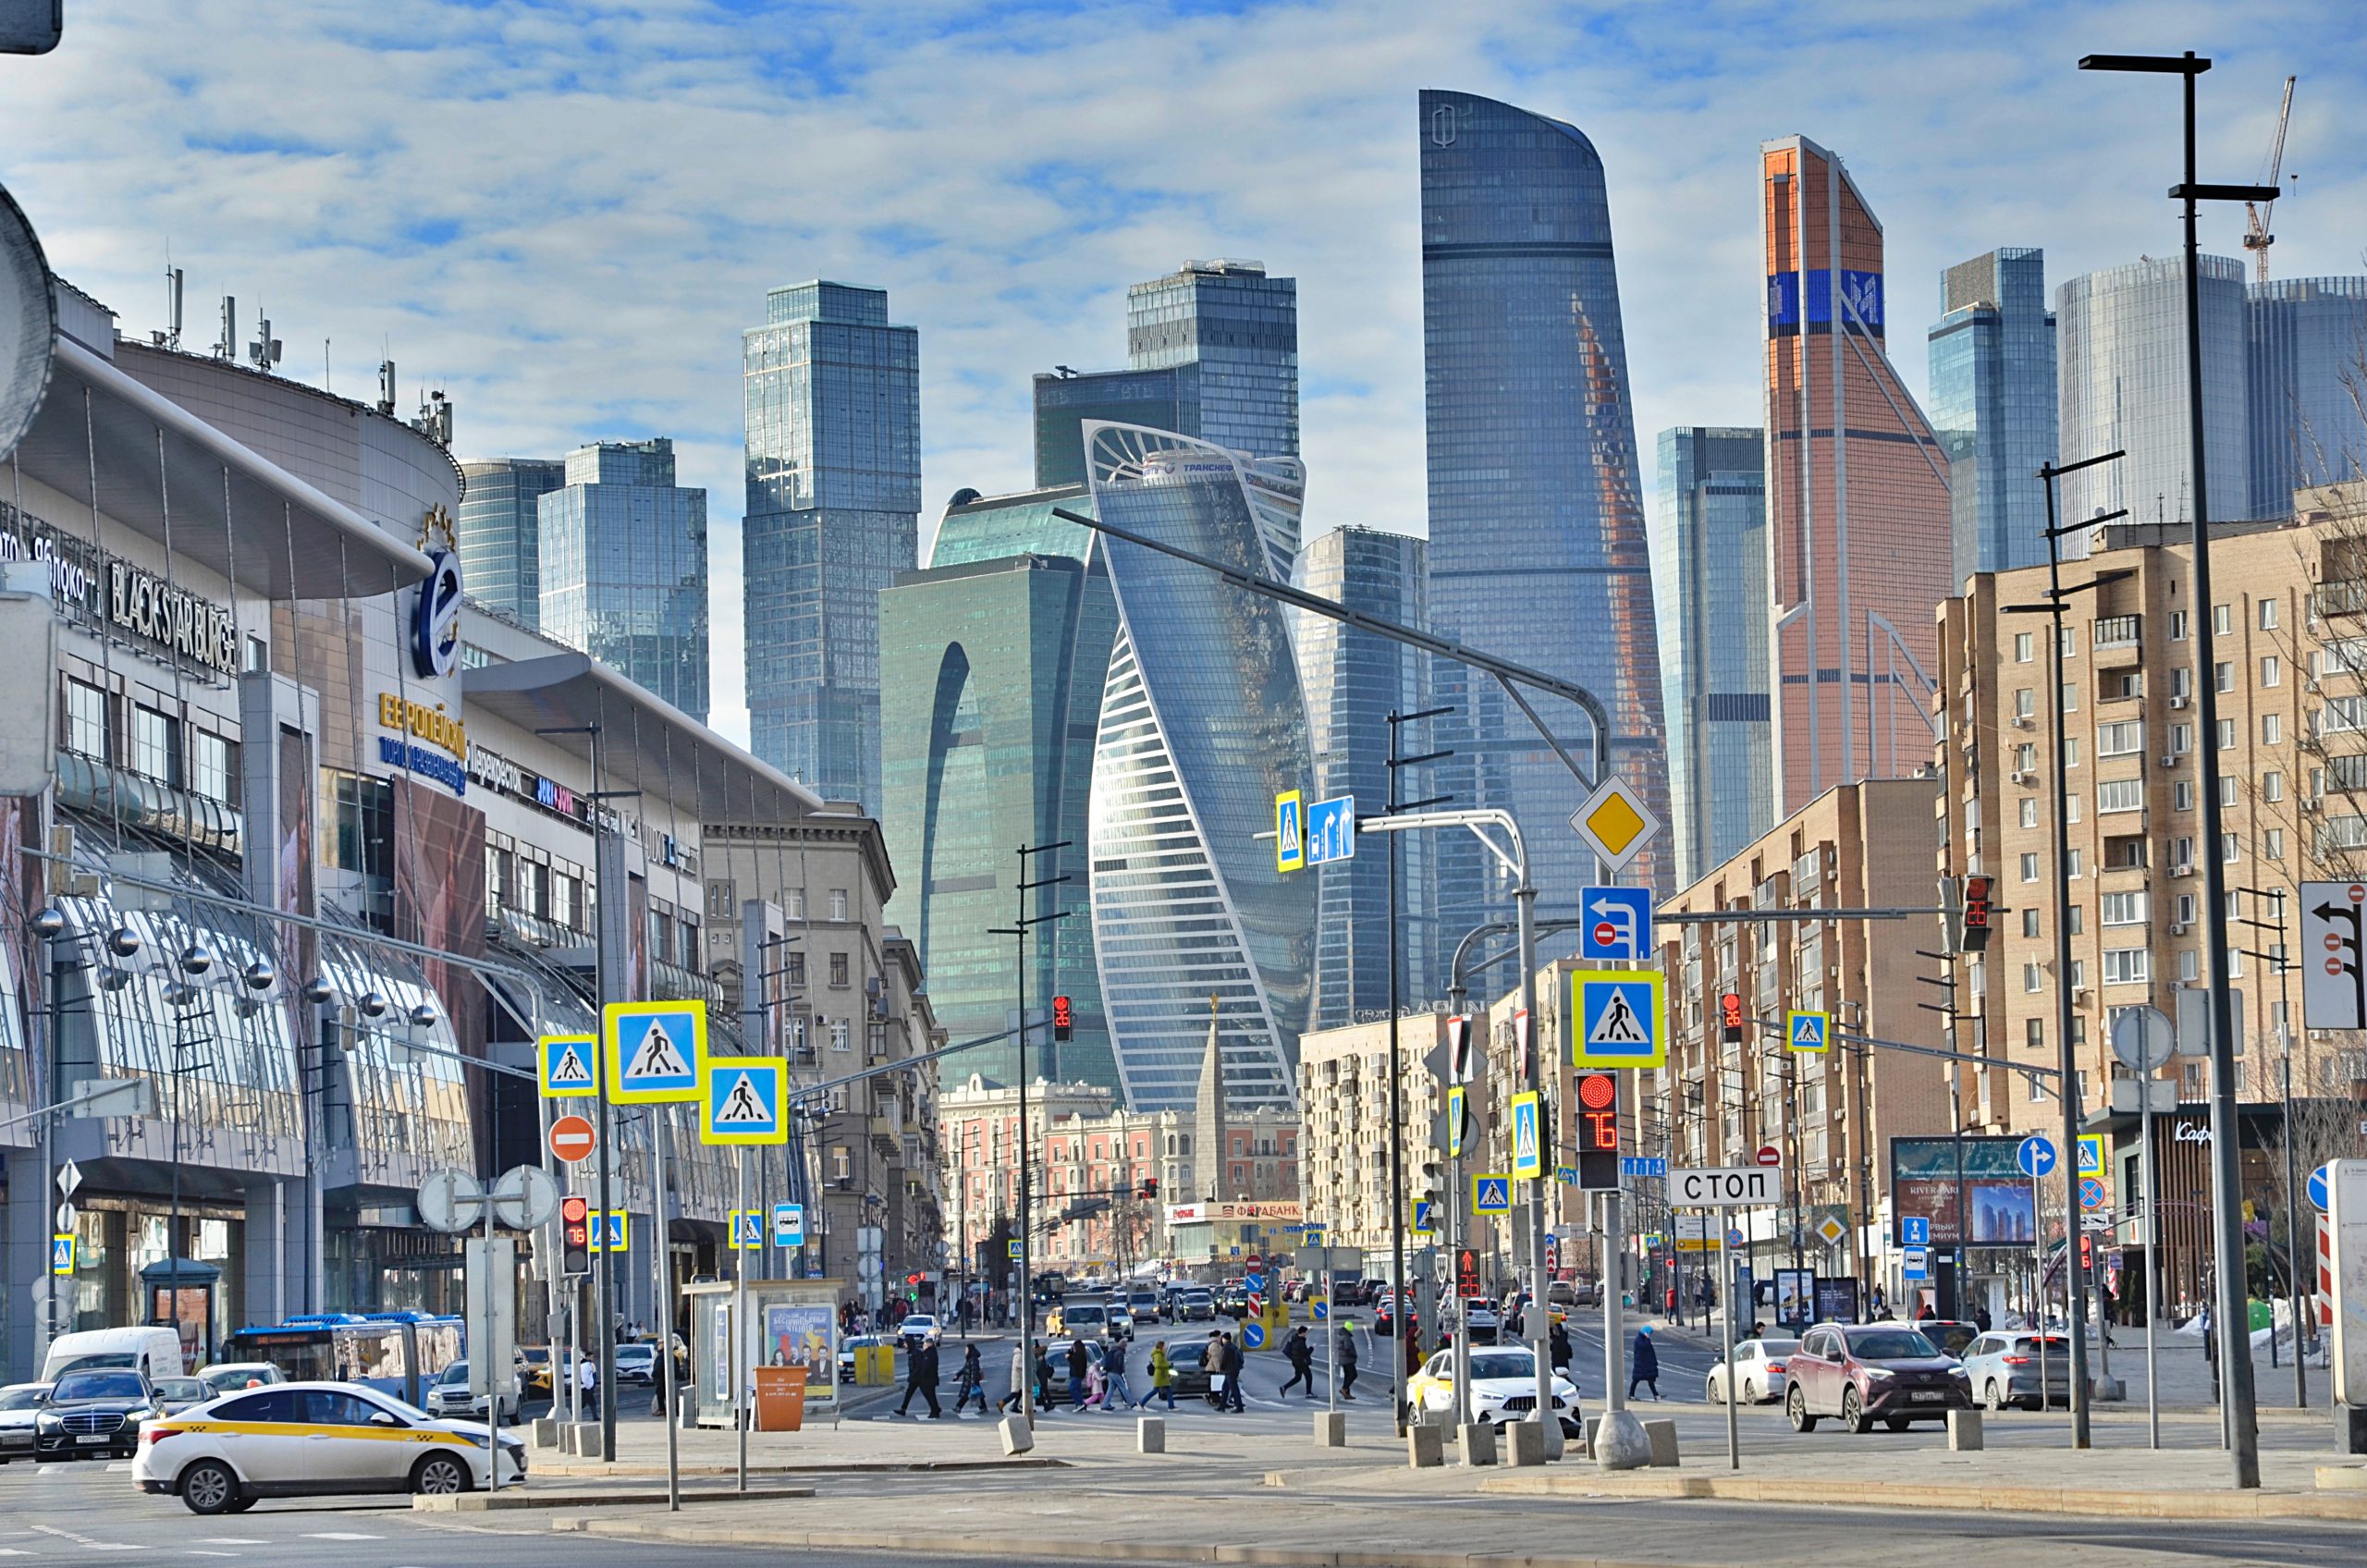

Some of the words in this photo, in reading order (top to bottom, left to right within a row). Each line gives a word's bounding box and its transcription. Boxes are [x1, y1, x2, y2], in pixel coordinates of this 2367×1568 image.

[111, 562, 161, 639] BLACK
[1056, 1011, 1069, 1026] 26
[1726, 1012, 1739, 1025] 26
[1586, 1114, 1616, 1147] 76
[1685, 1174, 1765, 1198] СТОП
[1910, 1186, 1936, 1194] RIVER
[1939, 1186, 1959, 1194] PAR
[1237, 1205, 1299, 1217] ФРАБАНК
[568, 1228, 583, 1243] 76
[1460, 1274, 1479, 1297] 26
